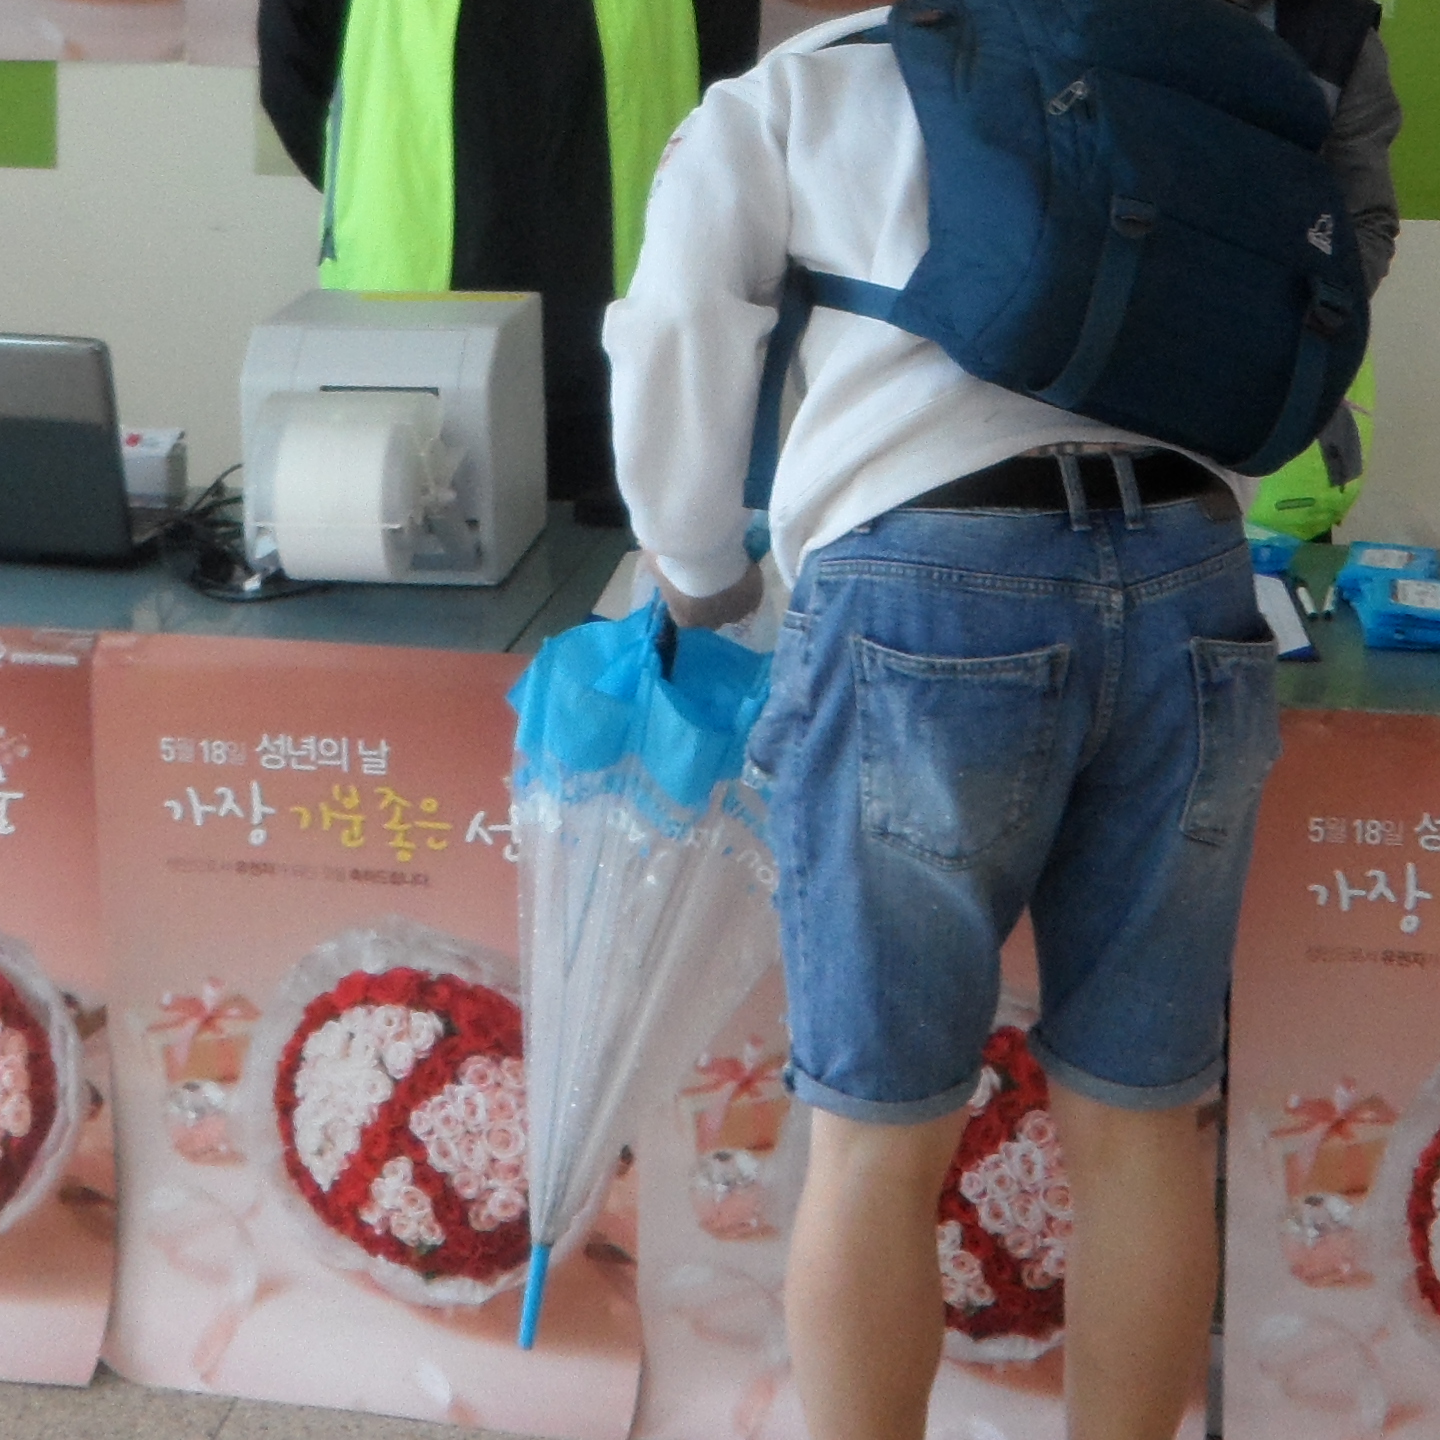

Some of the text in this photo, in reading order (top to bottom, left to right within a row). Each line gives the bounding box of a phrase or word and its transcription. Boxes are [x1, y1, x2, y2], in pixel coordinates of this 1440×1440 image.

[255, 733, 349, 773] 성년의
[358, 739, 389, 776] 날
[164, 780, 276, 846] 가장
[1307, 863, 1432, 934] 가장
